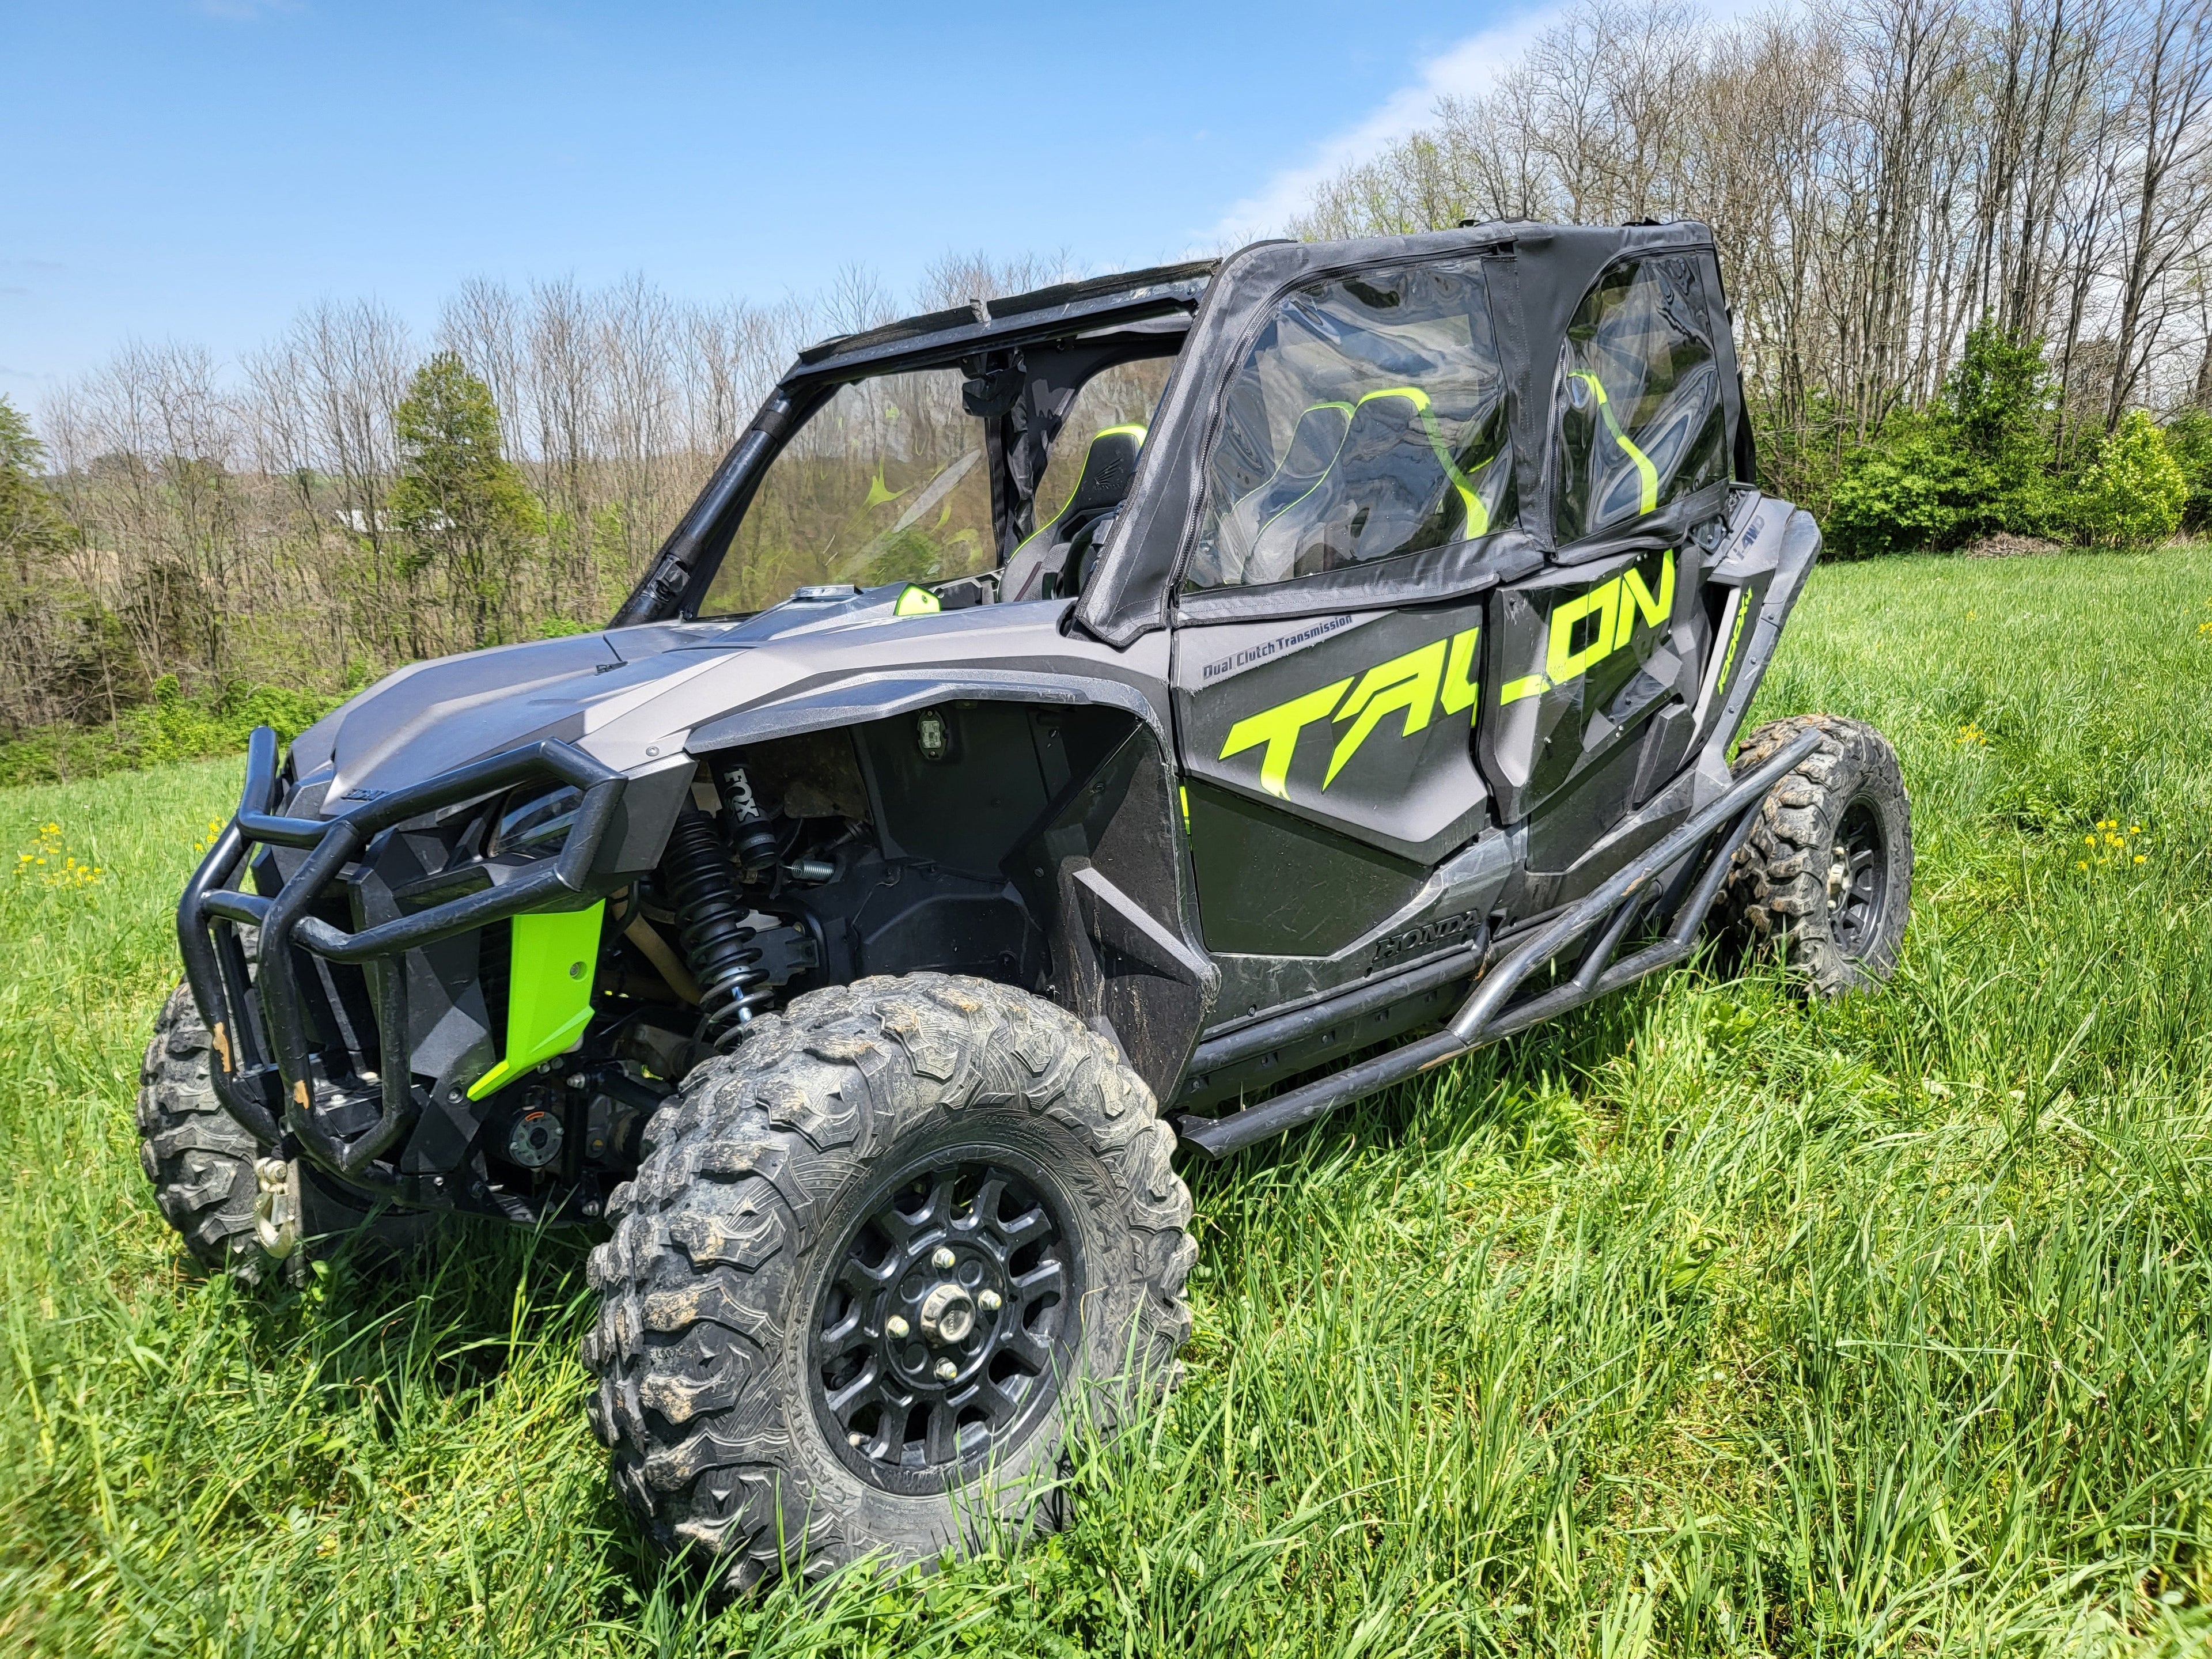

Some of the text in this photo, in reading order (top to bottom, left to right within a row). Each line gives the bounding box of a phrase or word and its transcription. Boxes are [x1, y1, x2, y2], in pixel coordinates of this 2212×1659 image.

[1203, 615, 1353, 680] Dual Clutch Transmission
[1218, 548, 1676, 801] TALON
[724, 768, 760, 822] FOX
[1373, 908, 1482, 963] HONDA
